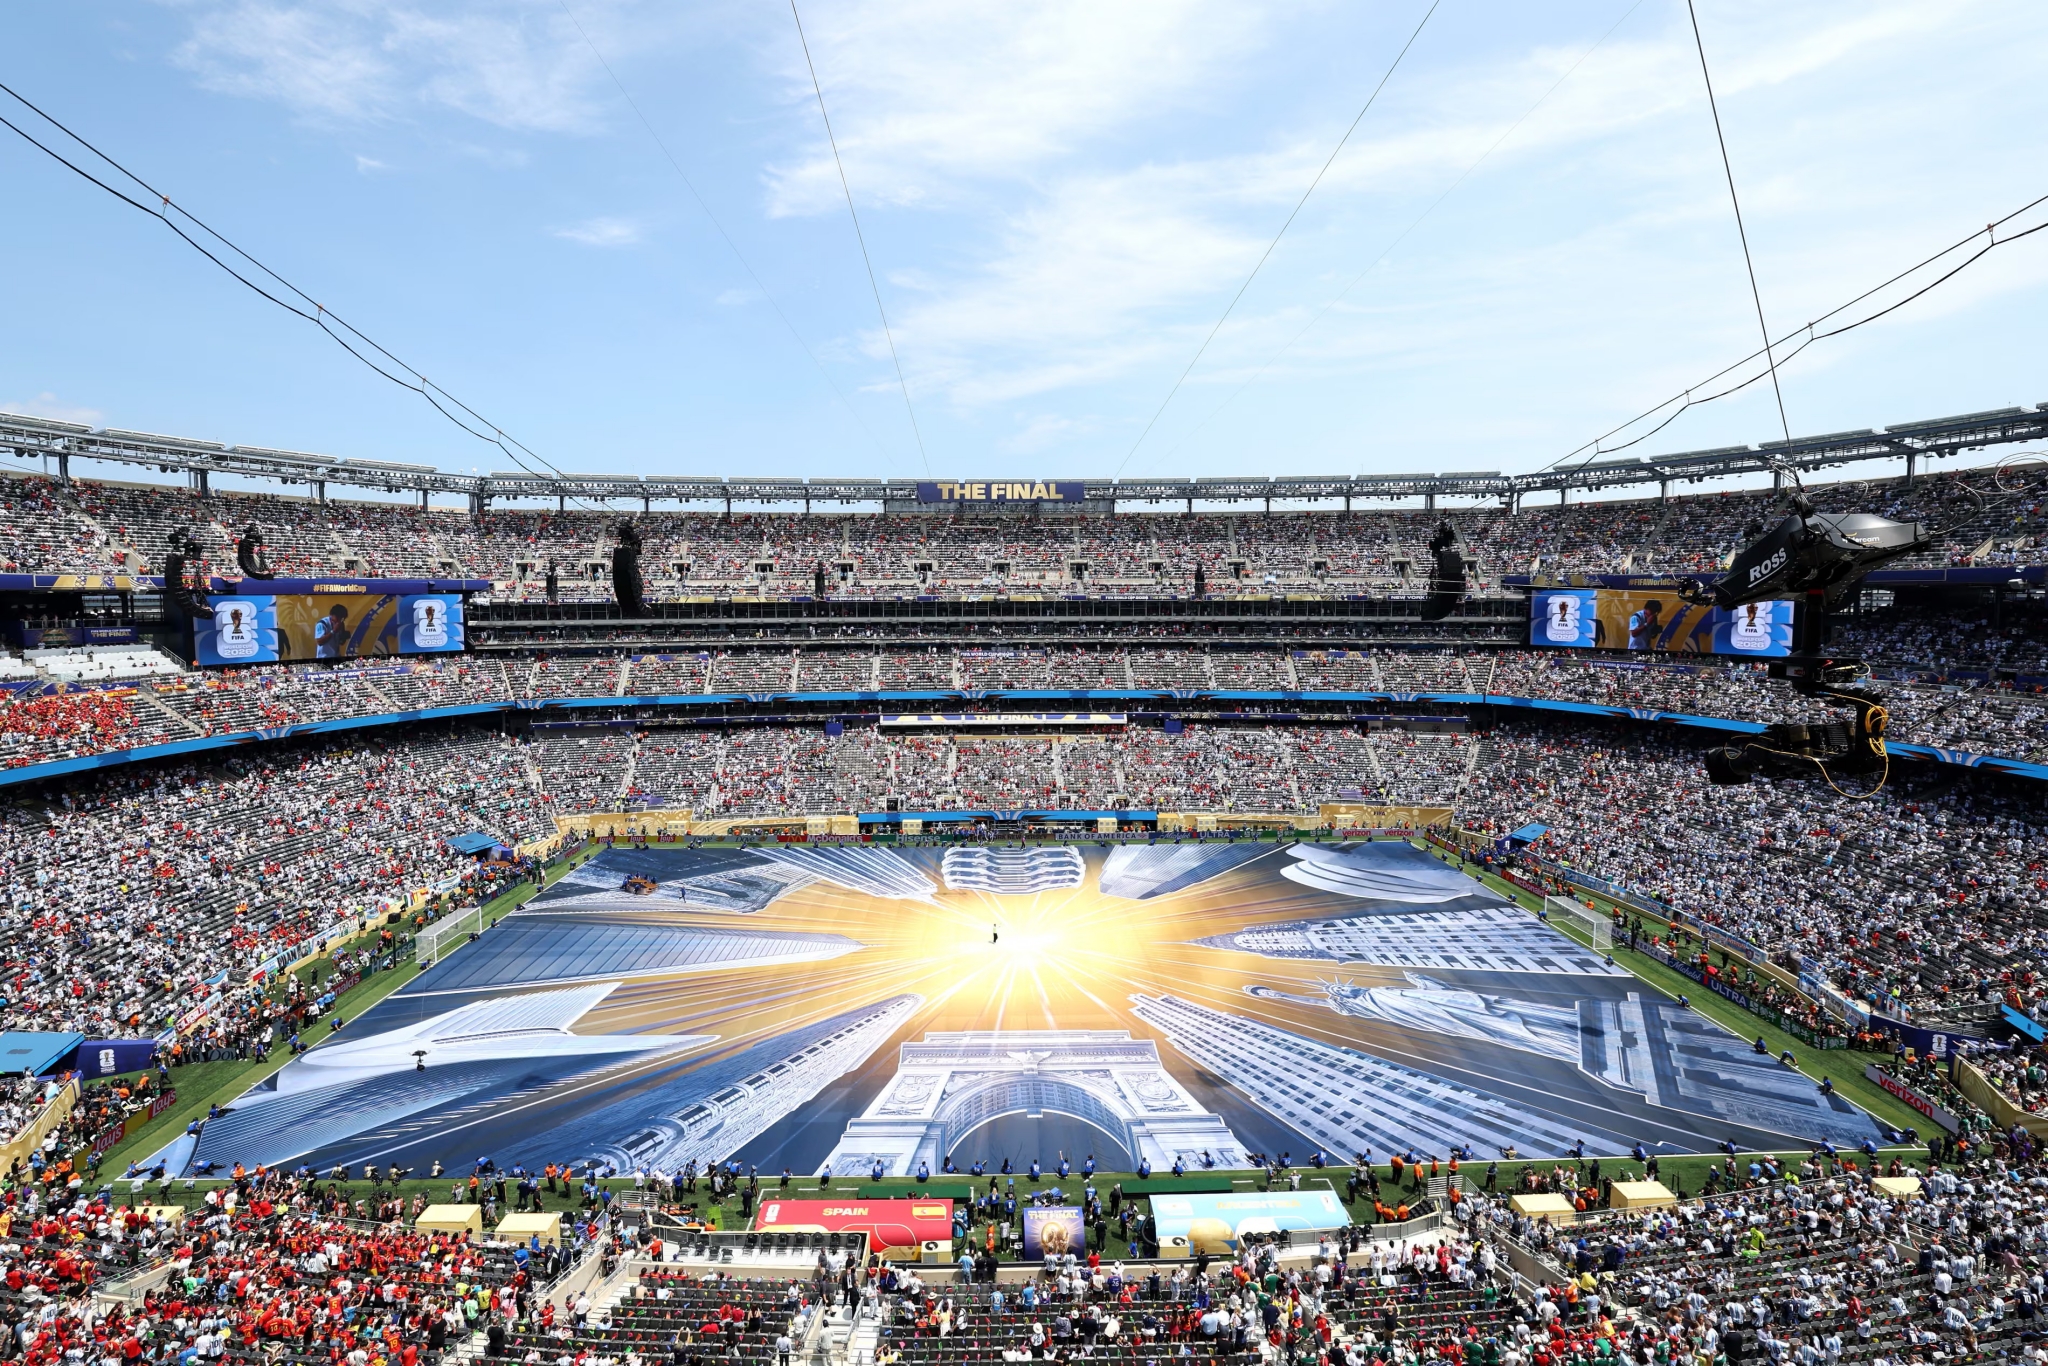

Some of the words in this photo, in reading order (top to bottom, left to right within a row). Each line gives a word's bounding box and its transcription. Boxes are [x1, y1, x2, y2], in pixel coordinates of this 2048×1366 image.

[937, 484, 986, 500] THE
[991, 484, 1064, 500] FINAL
[1750, 547, 1787, 582] ROSS
[313, 584, 366, 593] #FIFAWorldCup
[806, 834, 862, 842] McDonald's
[497, 883, 516, 895] ULTRA
[1668, 958, 1701, 981] Michelob
[1710, 980, 1747, 1007] ULTRA
[152, 1090, 176, 1118] Lay's
[1878, 1074, 1933, 1118] verizon
[96, 1126, 121, 1152] Lay's
[822, 1207, 868, 1216] SPAIN
